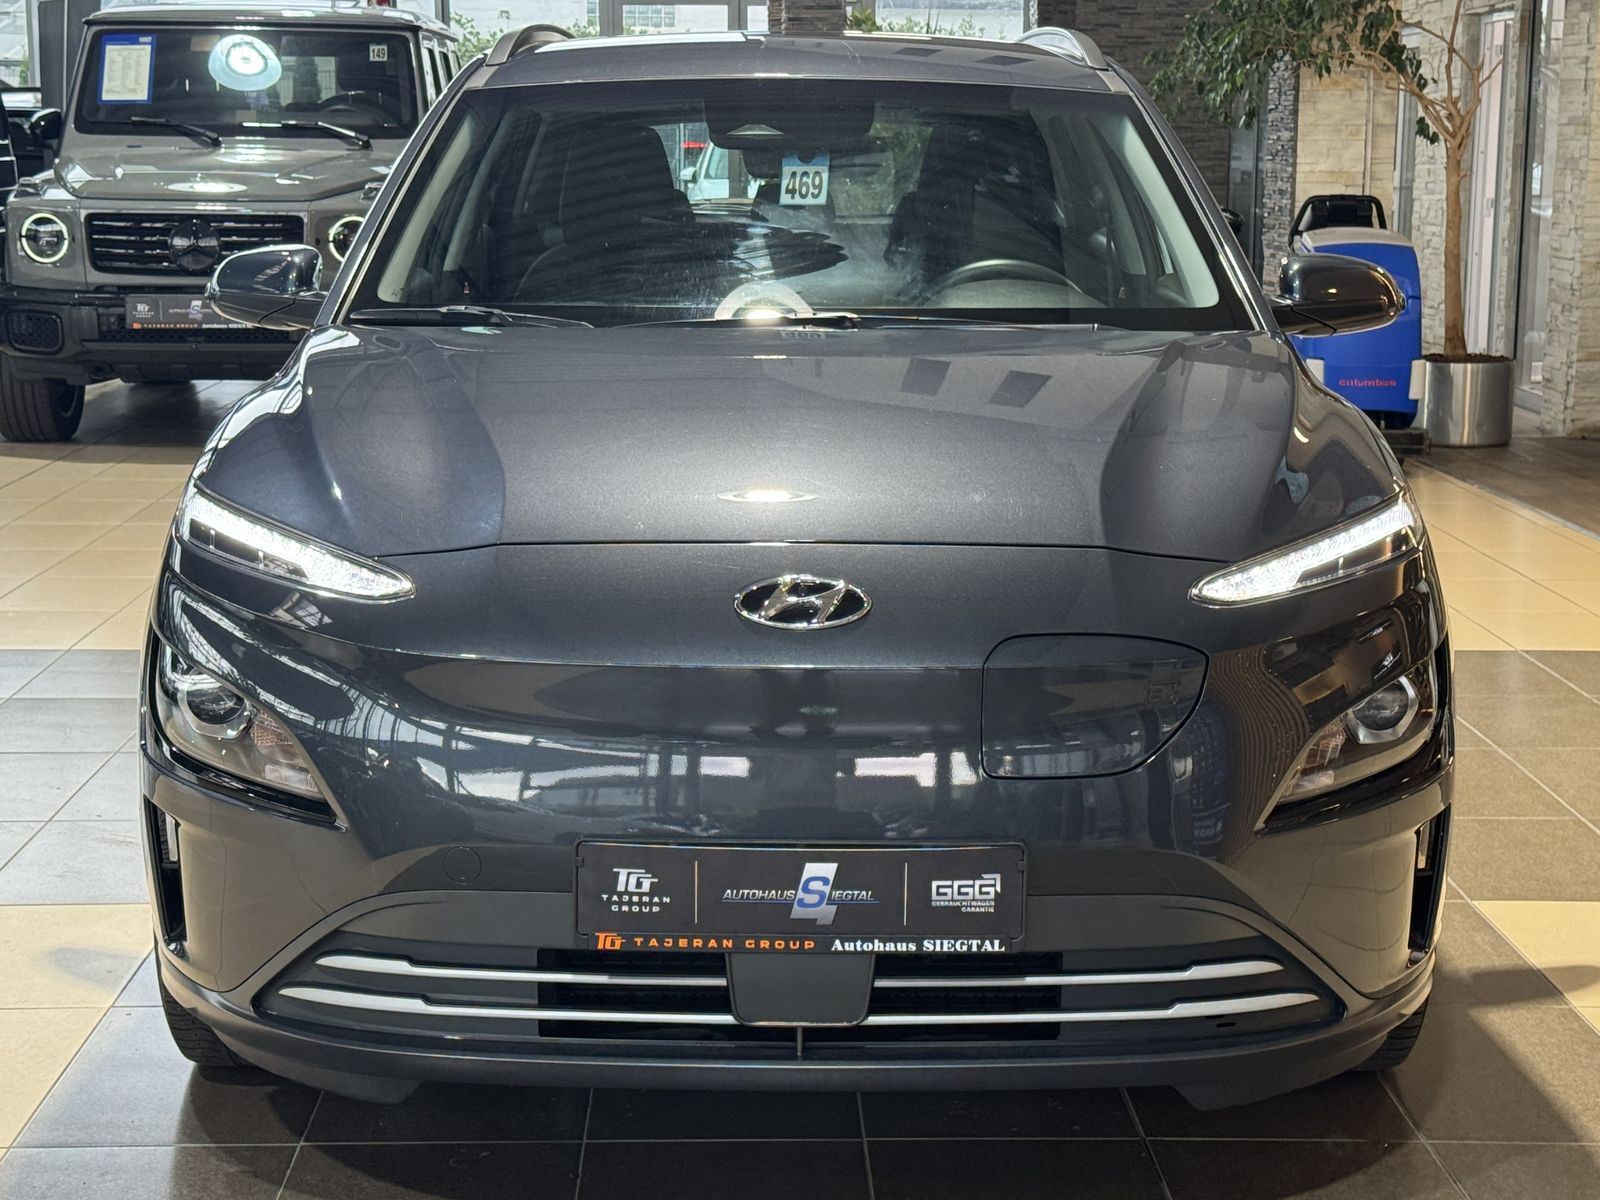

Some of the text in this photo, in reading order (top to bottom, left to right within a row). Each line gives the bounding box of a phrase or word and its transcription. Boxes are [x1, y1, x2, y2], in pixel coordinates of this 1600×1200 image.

[371, 47, 386, 60] 149
[784, 171, 823, 200] 469
[722, 889, 796, 900] AUTOHAUS
[931, 879, 995, 900] GGG
[611, 904, 660, 913] GROUP
[634, 938, 733, 949] TAJERAN
[745, 939, 815, 950] GROUP
[831, 939, 1006, 952] Autohaus SIEGTAL
